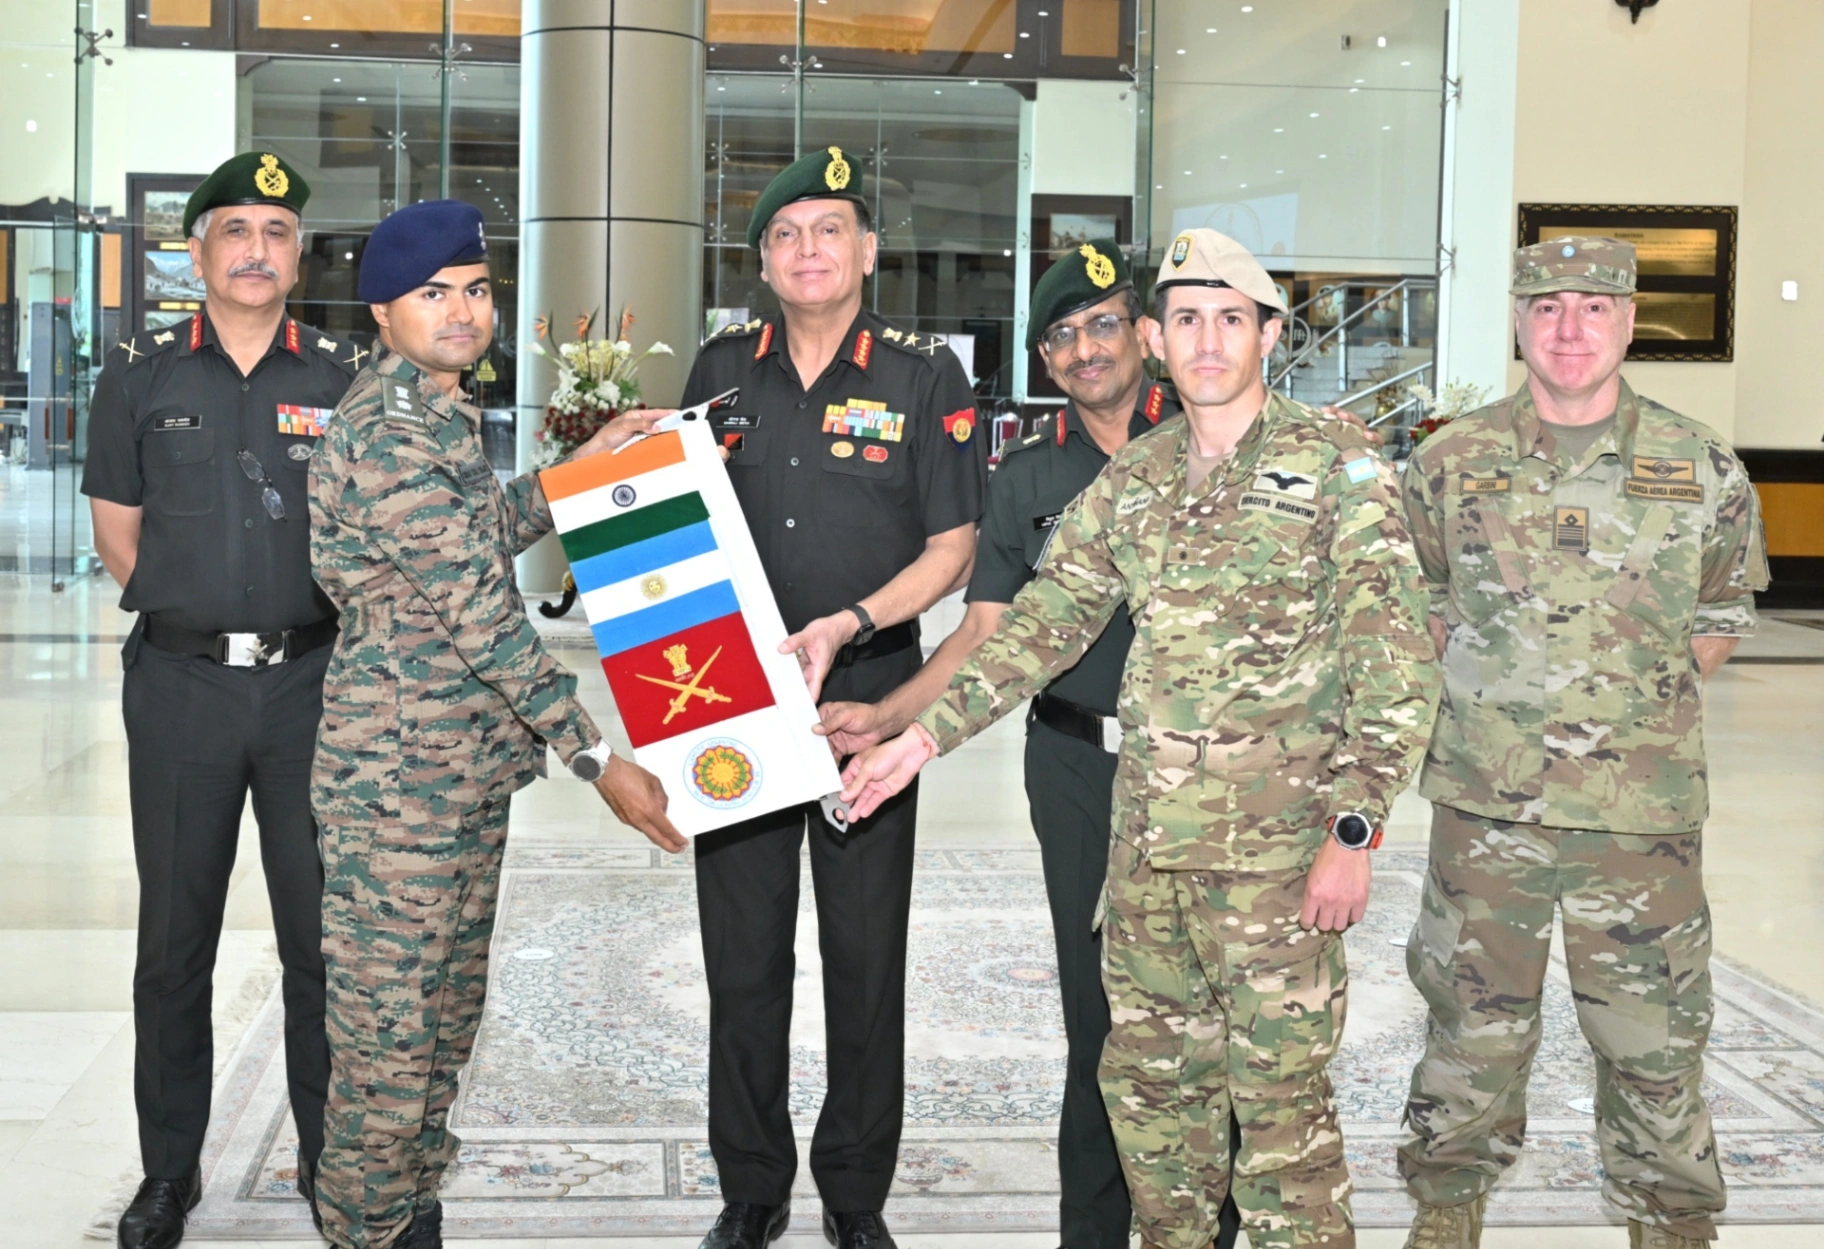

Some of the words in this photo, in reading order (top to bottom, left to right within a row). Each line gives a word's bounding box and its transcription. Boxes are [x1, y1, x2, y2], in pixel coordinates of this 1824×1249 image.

[1628, 483, 1648, 494] FUERZA
[1669, 487, 1701, 498] ARGENTINA
[1275, 500, 1316, 519] ARGENTINO
